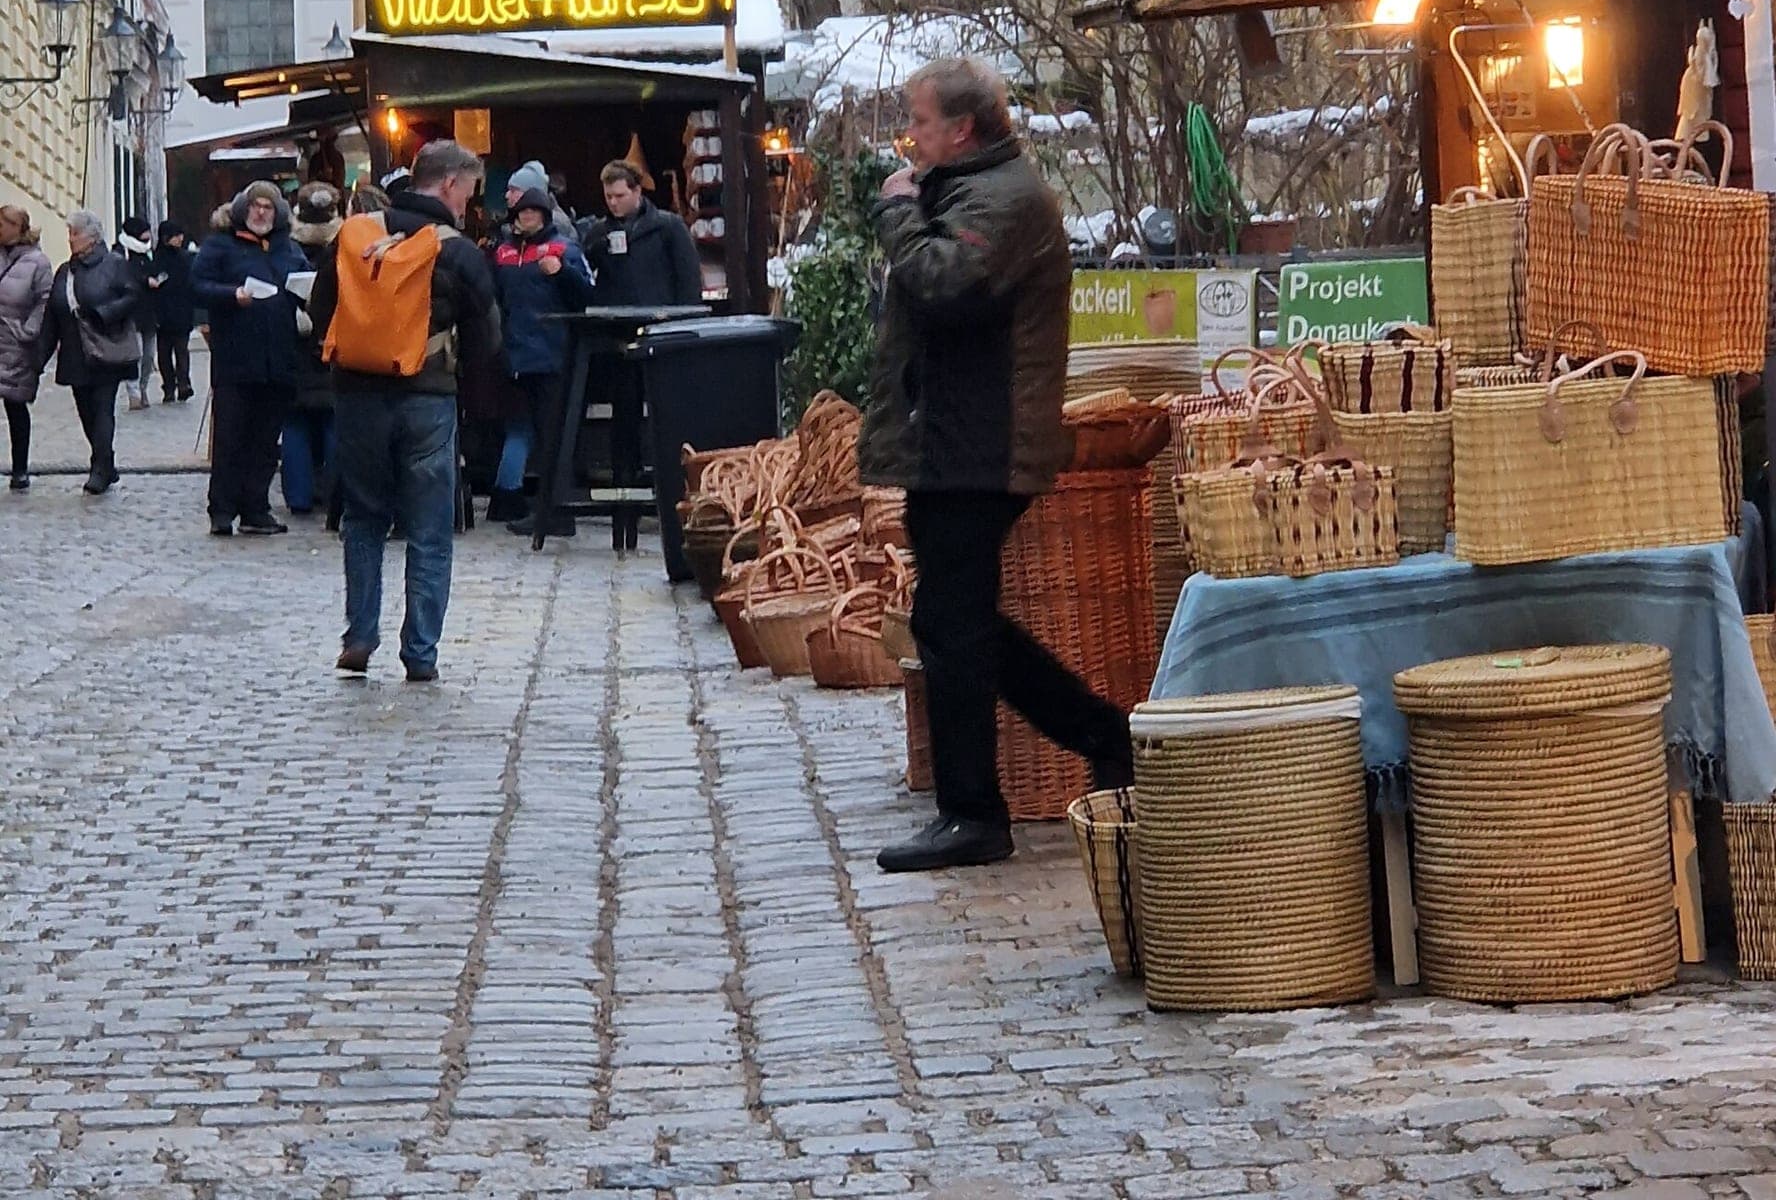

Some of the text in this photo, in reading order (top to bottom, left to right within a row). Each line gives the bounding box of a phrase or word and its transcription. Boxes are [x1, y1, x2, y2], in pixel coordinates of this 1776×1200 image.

[1070, 279, 1136, 317] ackerl,
[1289, 271, 1384, 304] Projekt
[1287, 314, 1420, 344] Donauk
